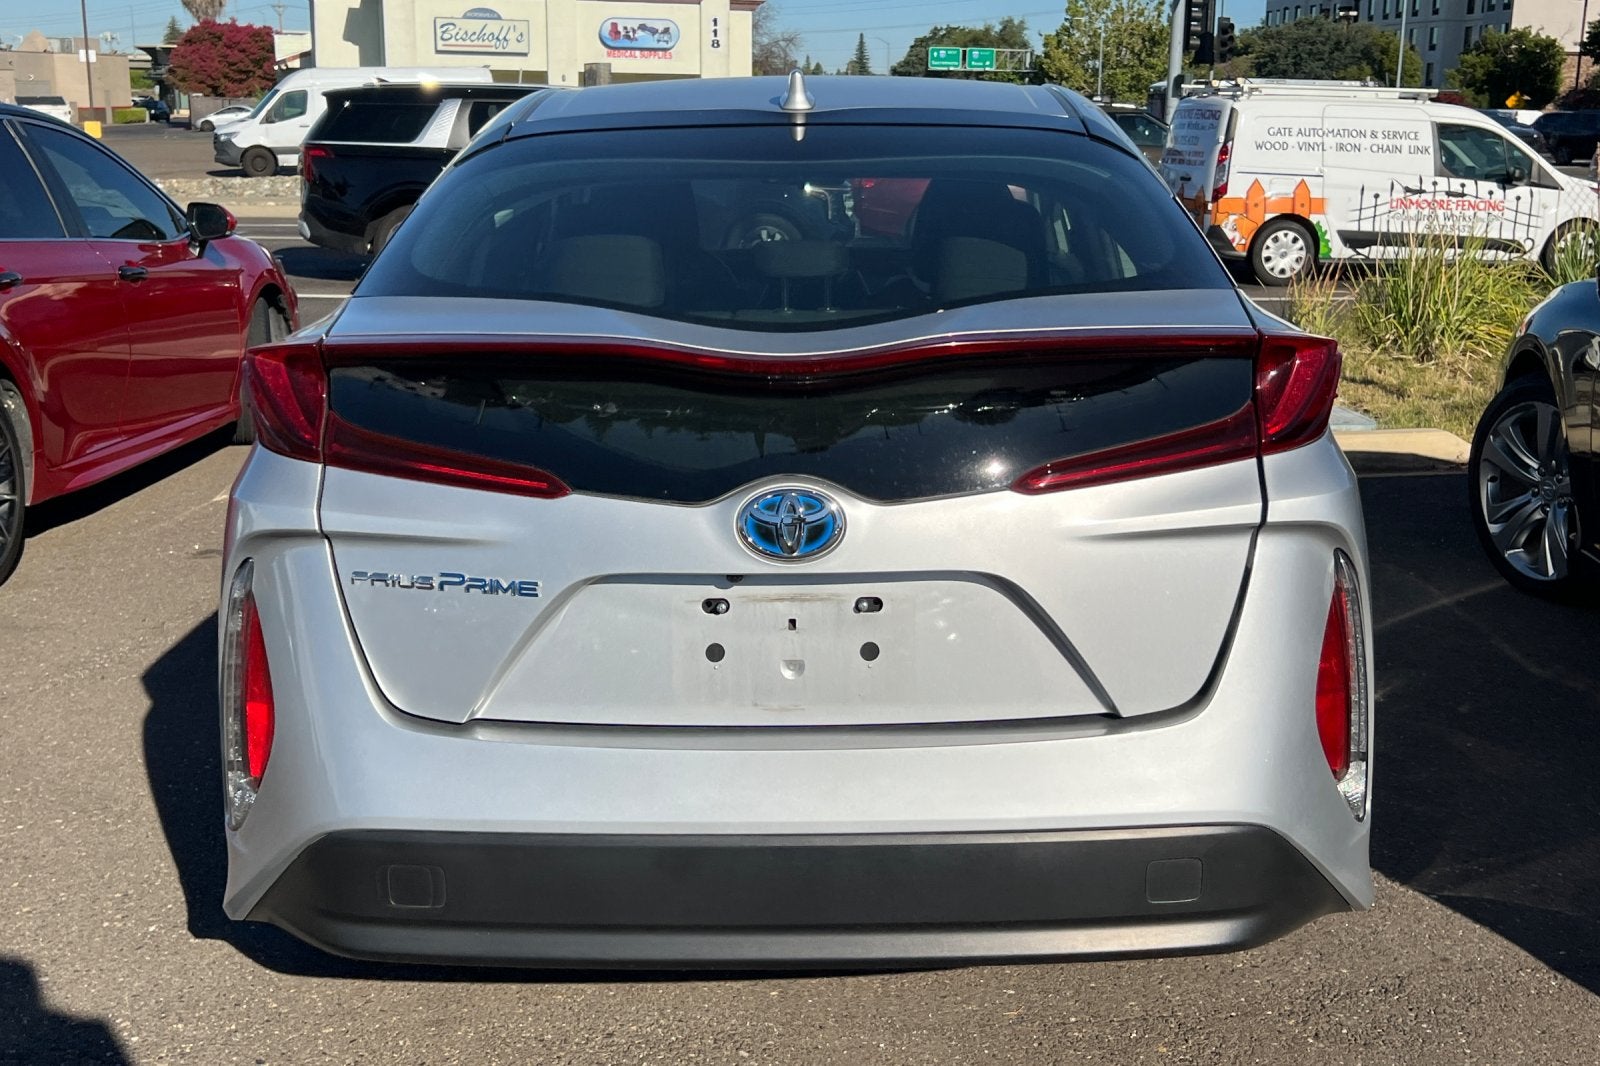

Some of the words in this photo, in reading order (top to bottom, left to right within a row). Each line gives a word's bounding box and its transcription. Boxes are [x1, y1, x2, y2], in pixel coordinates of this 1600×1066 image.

[439, 22, 526, 50] Bischoff's
[606, 49, 638, 59] MEDICAL
[639, 50, 673, 60] SUPPLIES
[1267, 127, 1293, 137] GATE
[1296, 127, 1367, 139] AUTOMATION
[1370, 129, 1379, 139] &
[1381, 130, 1420, 141] SERVICE
[1254, 141, 1289, 151] WOOD
[1297, 141, 1327, 152] VINYL
[1335, 142, 1361, 153] IRON
[1369, 144, 1402, 154] CHAIN
[1408, 145, 1432, 155] LINK
[1389, 198, 1453, 210] LINMOORE
[1455, 199, 1505, 212] FENCING
[1442, 211, 1472, 223] Works
[350, 570, 436, 590] PRIUS
[438, 572, 543, 597] PRIME
